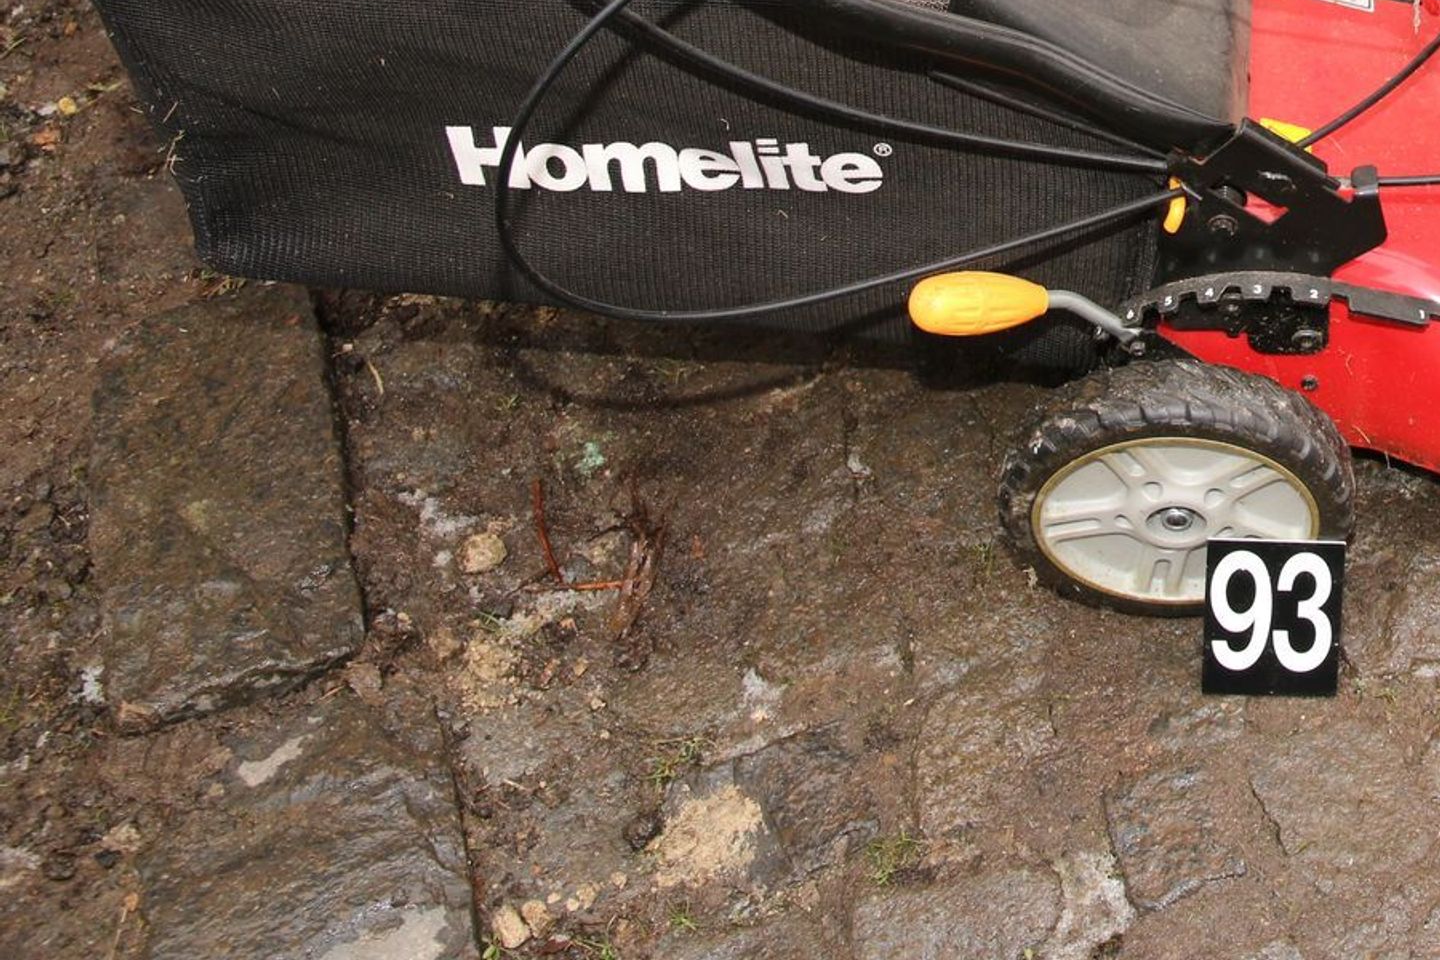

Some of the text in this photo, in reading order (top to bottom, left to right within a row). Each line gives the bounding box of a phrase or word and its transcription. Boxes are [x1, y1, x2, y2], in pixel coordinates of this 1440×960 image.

[1164, 295, 1173, 307] 5
[1204, 287, 1214, 297] 4
[1253, 284, 1263, 294] 3
[1310, 289, 1319, 299] 2
[1418, 308, 1426, 320] 1
[1210, 550, 1332, 673] 93
